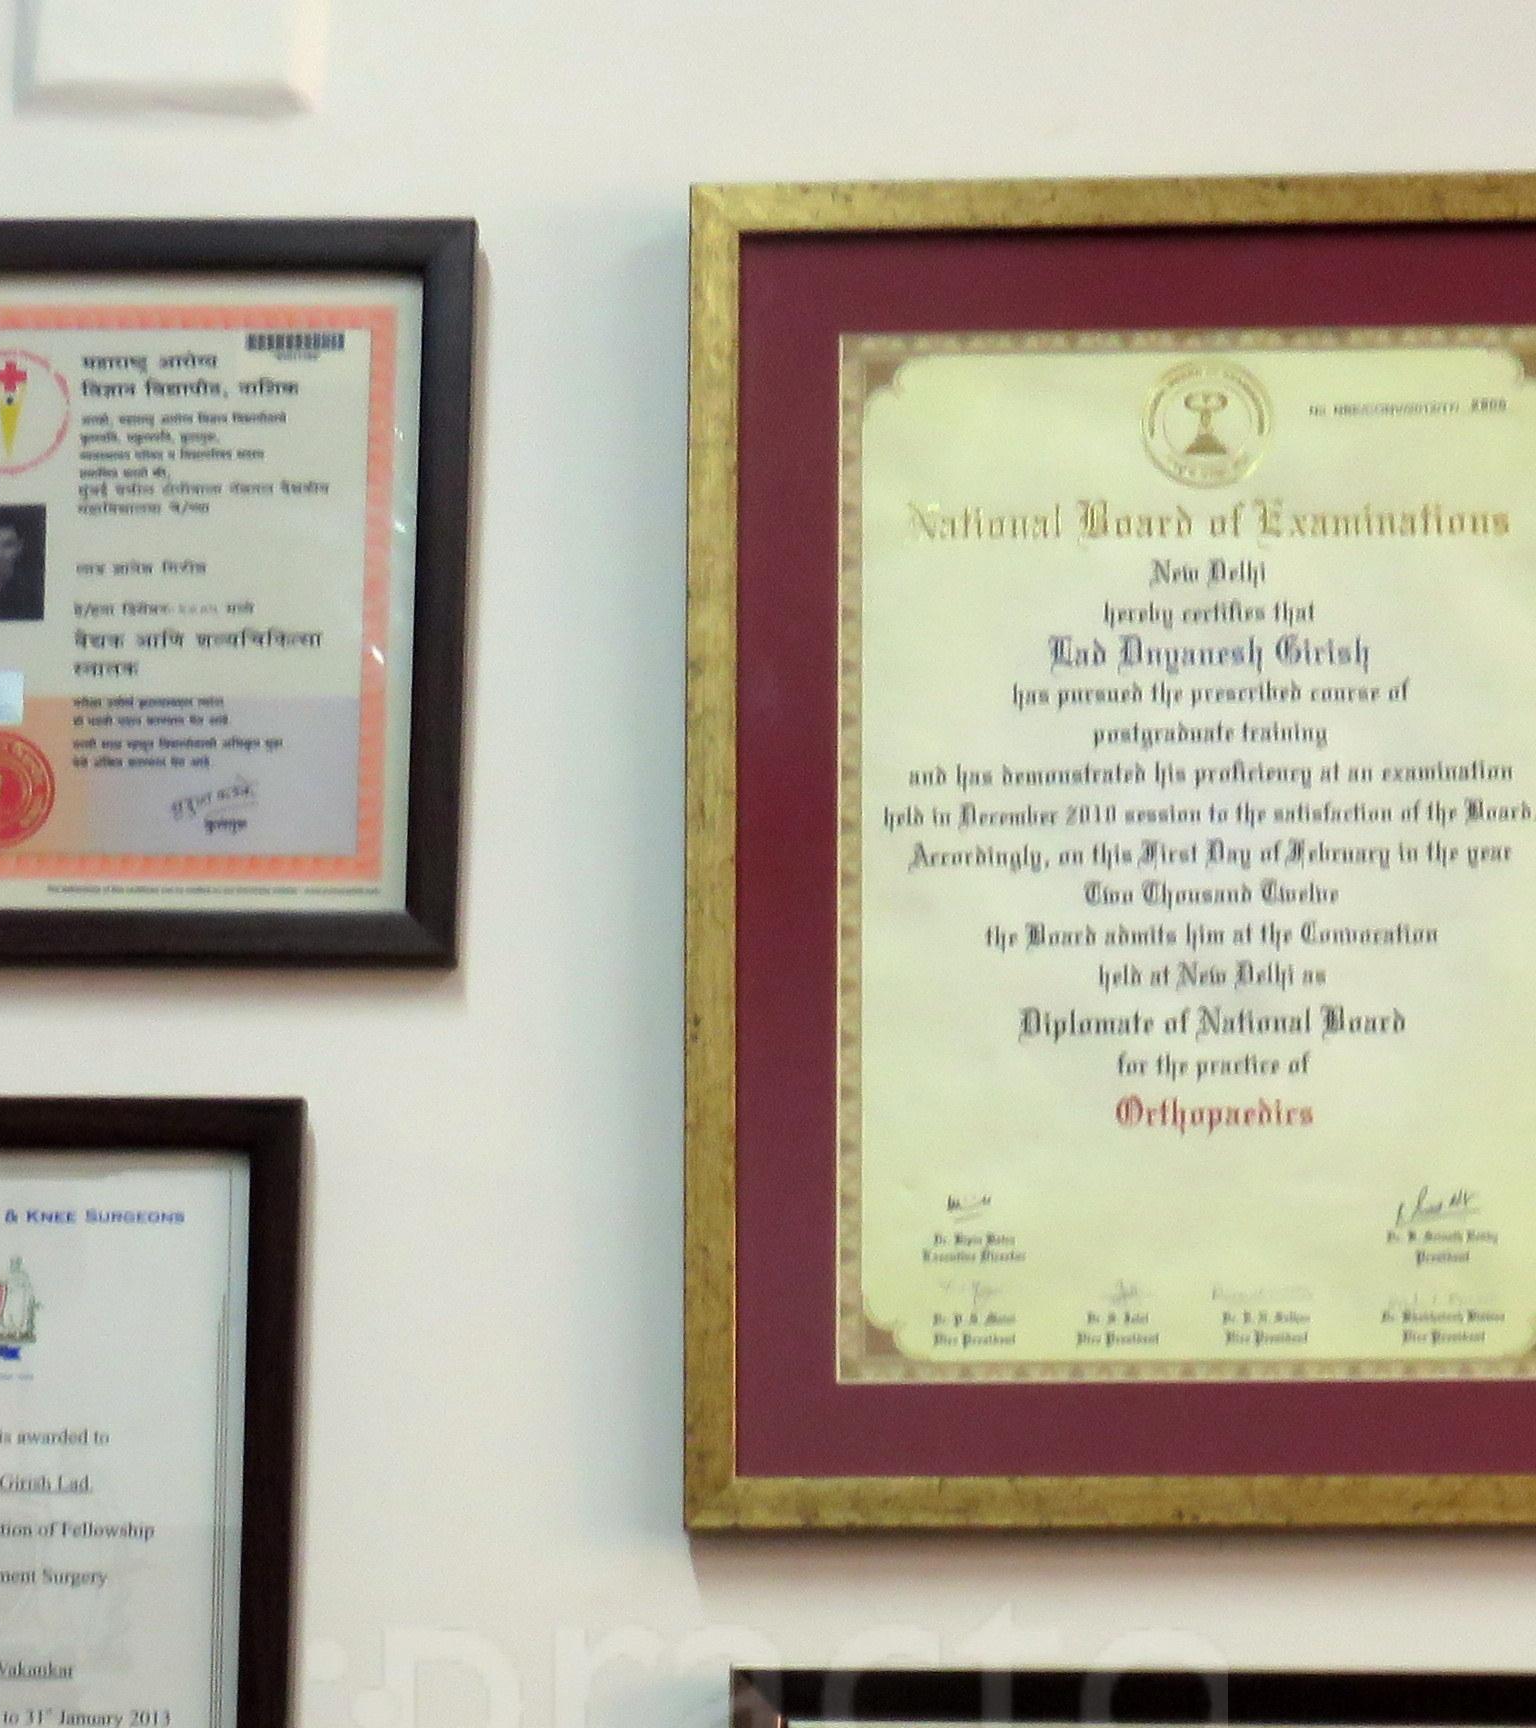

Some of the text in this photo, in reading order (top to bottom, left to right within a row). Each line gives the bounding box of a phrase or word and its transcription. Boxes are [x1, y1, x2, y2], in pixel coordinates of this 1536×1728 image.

[908, 498, 1511, 550] National Board of Examinations
[1149, 558, 1268, 589] New Delhi
[1103, 599, 1316, 631] hereby certifies that
[1048, 632, 1371, 676] Lad Dnyanesh Girish
[1013, 677, 1412, 711] has pursued the prescribed course of
[1093, 721, 1329, 751] postgraduate training
[909, 759, 1514, 793] and has demonstrated his proficiency at an examination
[884, 805, 926, 834] held
[932, 807, 953, 829] in
[958, 802, 1059, 833] December
[1066, 804, 1118, 827] 2010
[1125, 804, 1203, 826] session
[1208, 803, 1230, 826] to
[1235, 799, 1268, 831] the
[1274, 801, 1394, 825] satisfaction
[1400, 799, 1423, 825] of
[1426, 799, 1459, 830] the
[907, 836, 1513, 873] Accordingly, on this First Day of February in the year
[1084, 879, 1341, 912] Two Thousand Twelve
[985, 920, 1439, 953] the Board admits him at the Convocation
[1099, 958, 1328, 994] held at New Delhi as
[1018, 1004, 1407, 1045] Diplomate of National Board
[1117, 1051, 1312, 1084] for the practice of
[1115, 1093, 1315, 1138] Orthopaedics
[26, 1210, 77, 1225] KNEE
[86, 1209, 187, 1226] SURGEONS
[17, 1428, 90, 1448] awarded
[93, 1430, 111, 1447] to
[57, 1473, 90, 1494] Lad
[37, 1521, 57, 1539] of
[61, 1521, 157, 1542] Fellowship
[42, 1568, 109, 1590] Surgery
[3, 1711, 21, 1727] to
[130, 1709, 172, 1728] 2013
